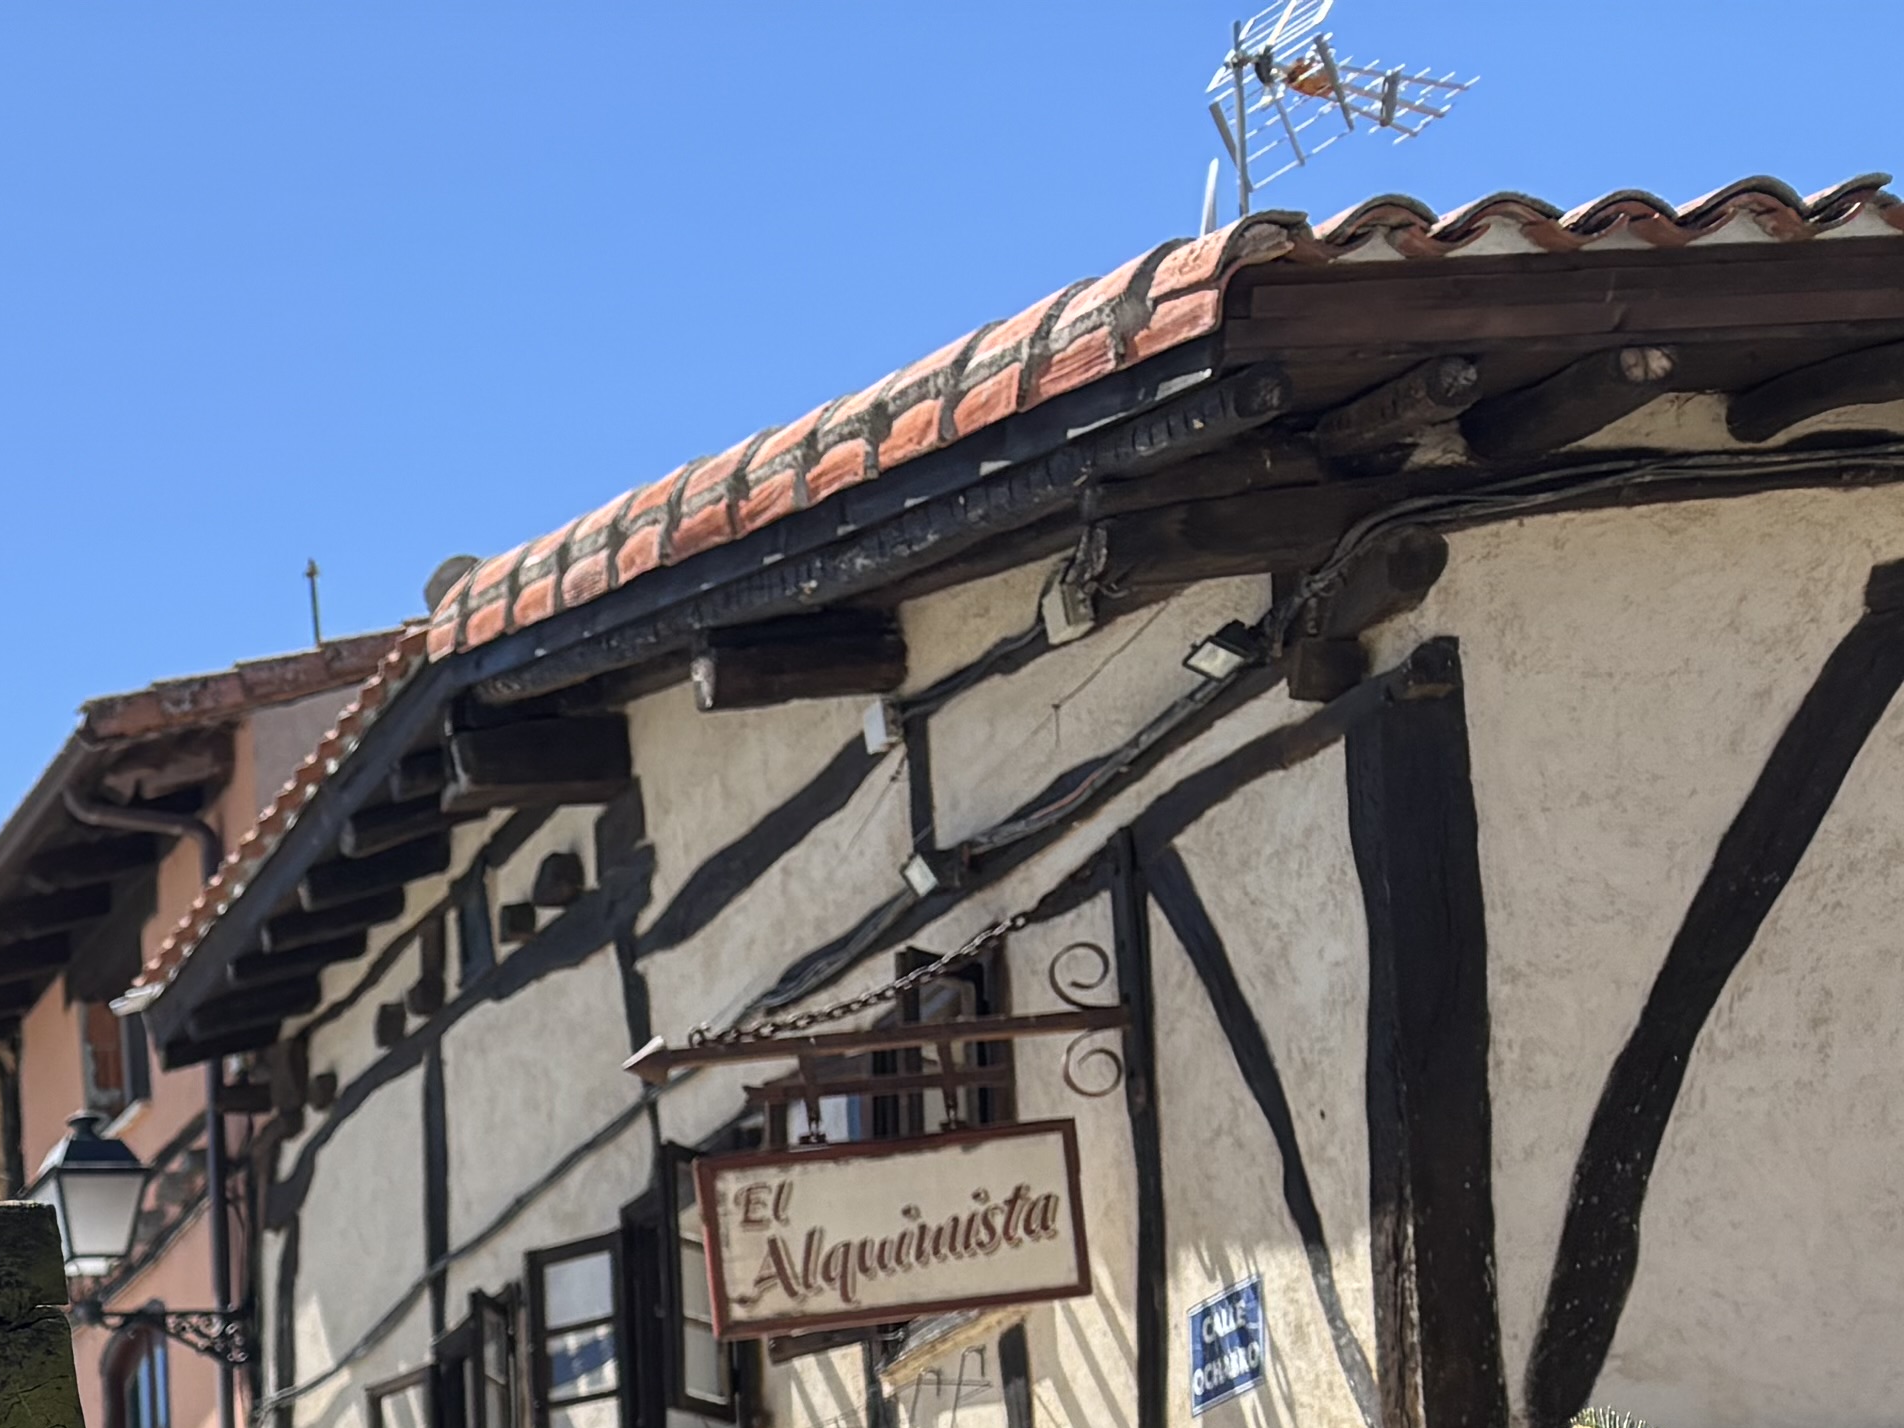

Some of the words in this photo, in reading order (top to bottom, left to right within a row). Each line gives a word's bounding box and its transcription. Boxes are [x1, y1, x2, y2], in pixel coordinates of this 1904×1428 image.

[734, 1179, 794, 1231] El
[729, 1182, 1059, 1306] Alquimista
[1202, 1299, 1246, 1344] CALLE
